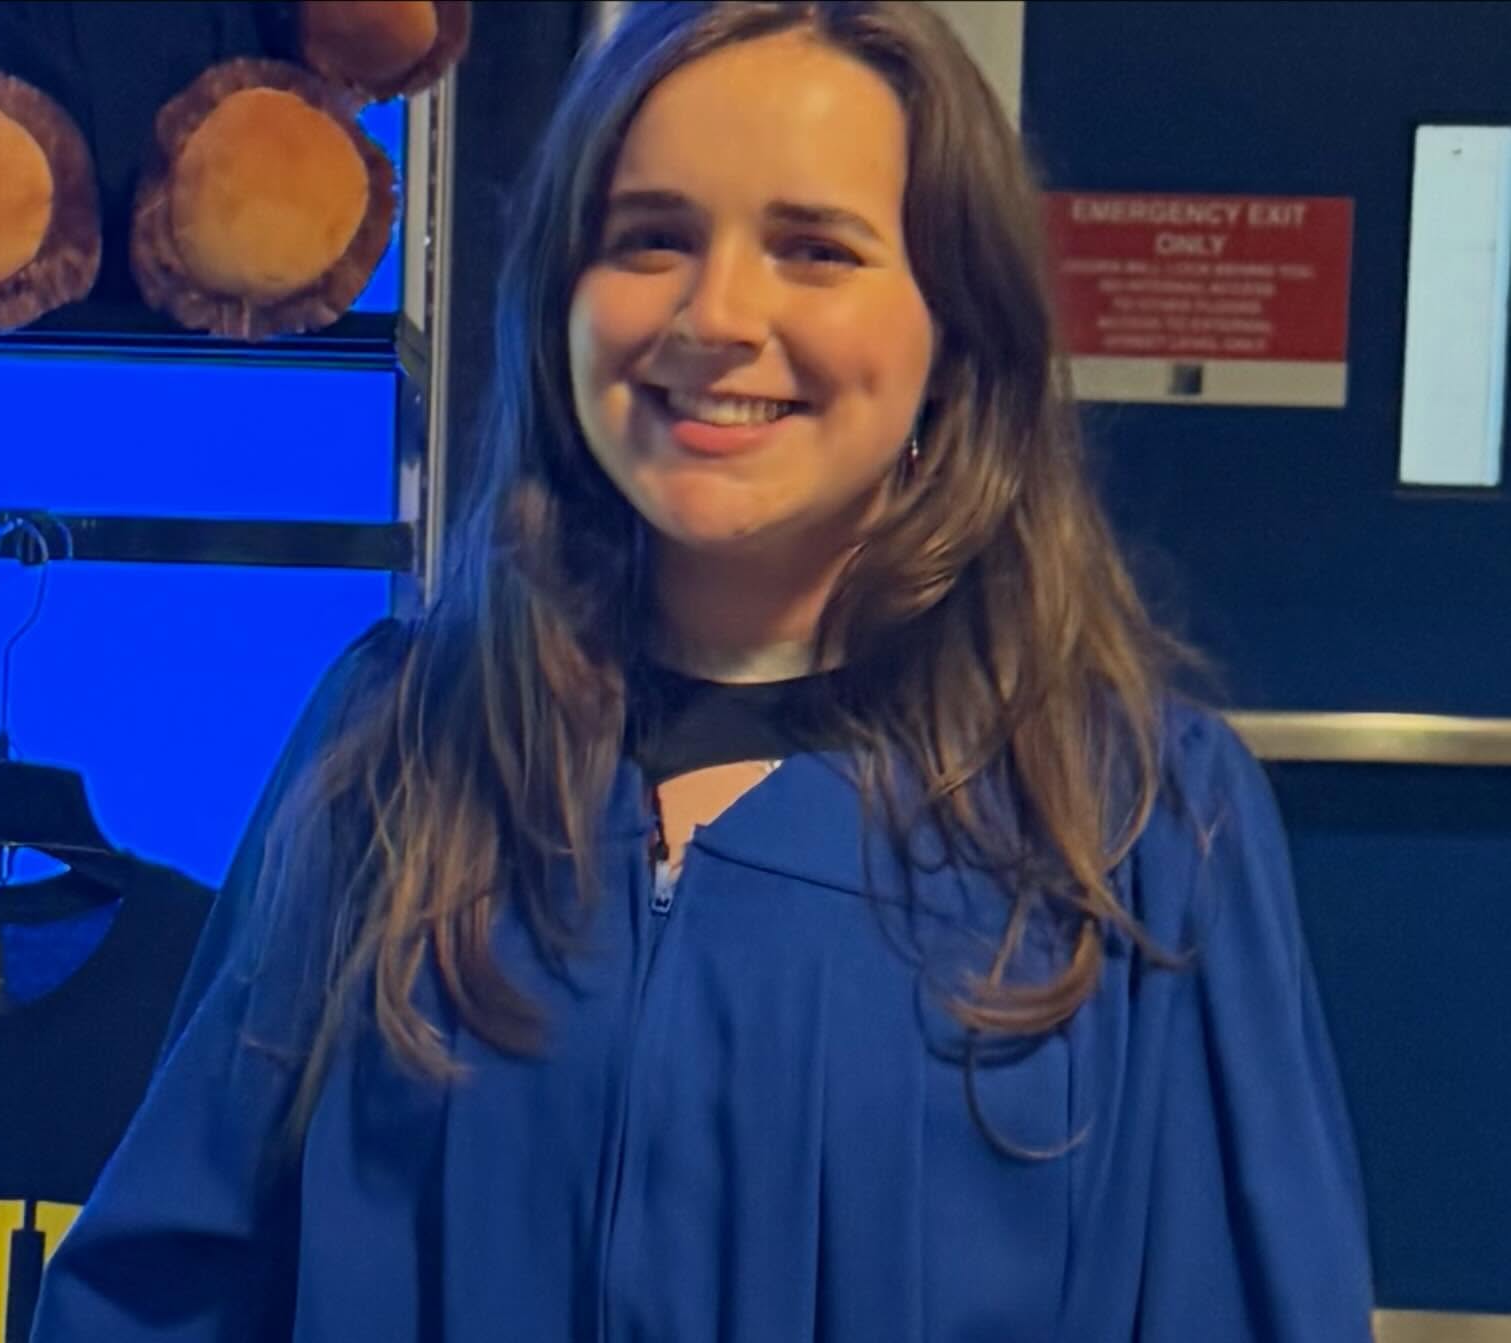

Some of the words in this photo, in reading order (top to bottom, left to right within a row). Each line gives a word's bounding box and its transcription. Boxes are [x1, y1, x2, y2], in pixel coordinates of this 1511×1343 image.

[1072, 201, 1242, 226] EMERGENCY
[1248, 203, 1306, 228] EXIT
[1155, 233, 1227, 255] ONLY
